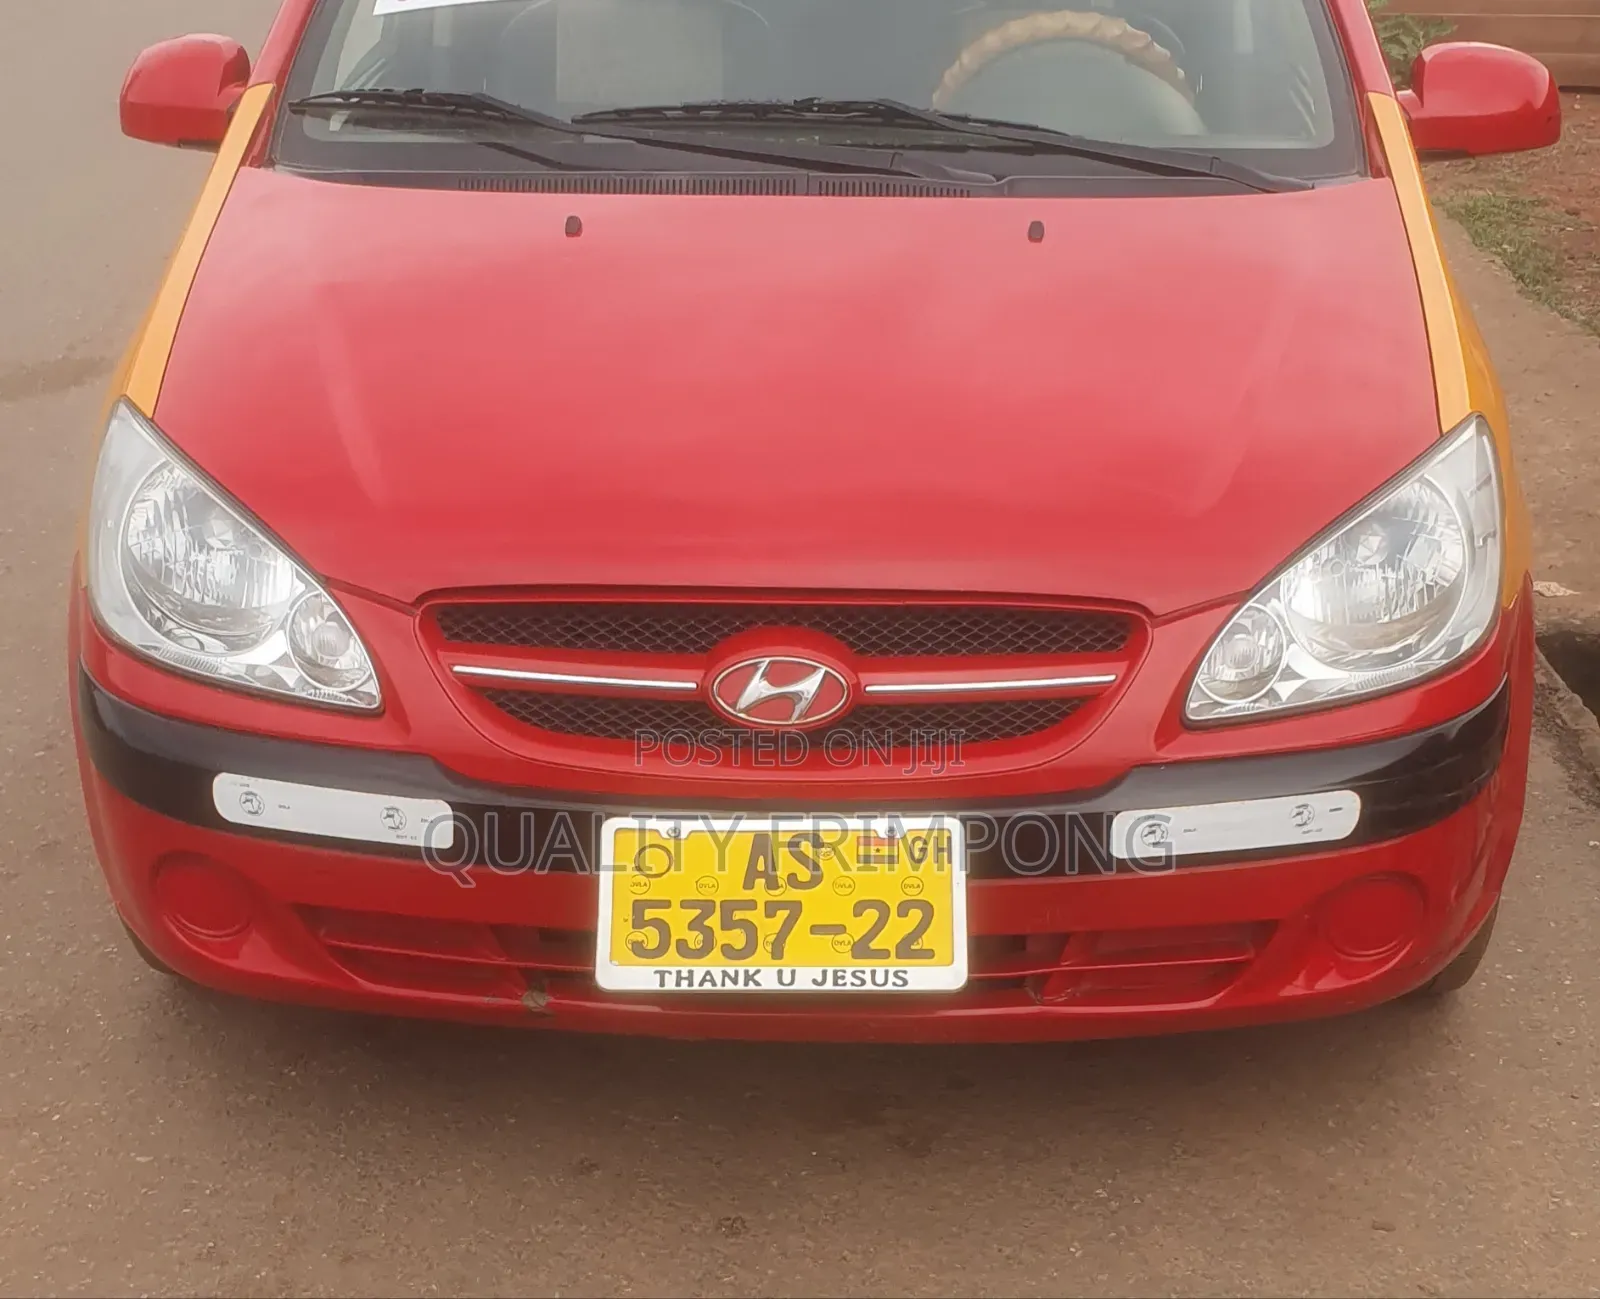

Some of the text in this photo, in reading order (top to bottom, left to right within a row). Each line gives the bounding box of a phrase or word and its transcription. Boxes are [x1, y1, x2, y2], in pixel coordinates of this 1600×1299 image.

[742, 832, 824, 891] AS
[909, 836, 952, 864] GH
[631, 899, 936, 960] 5357-22
[653, 969, 910, 988] THANK U JESUS
